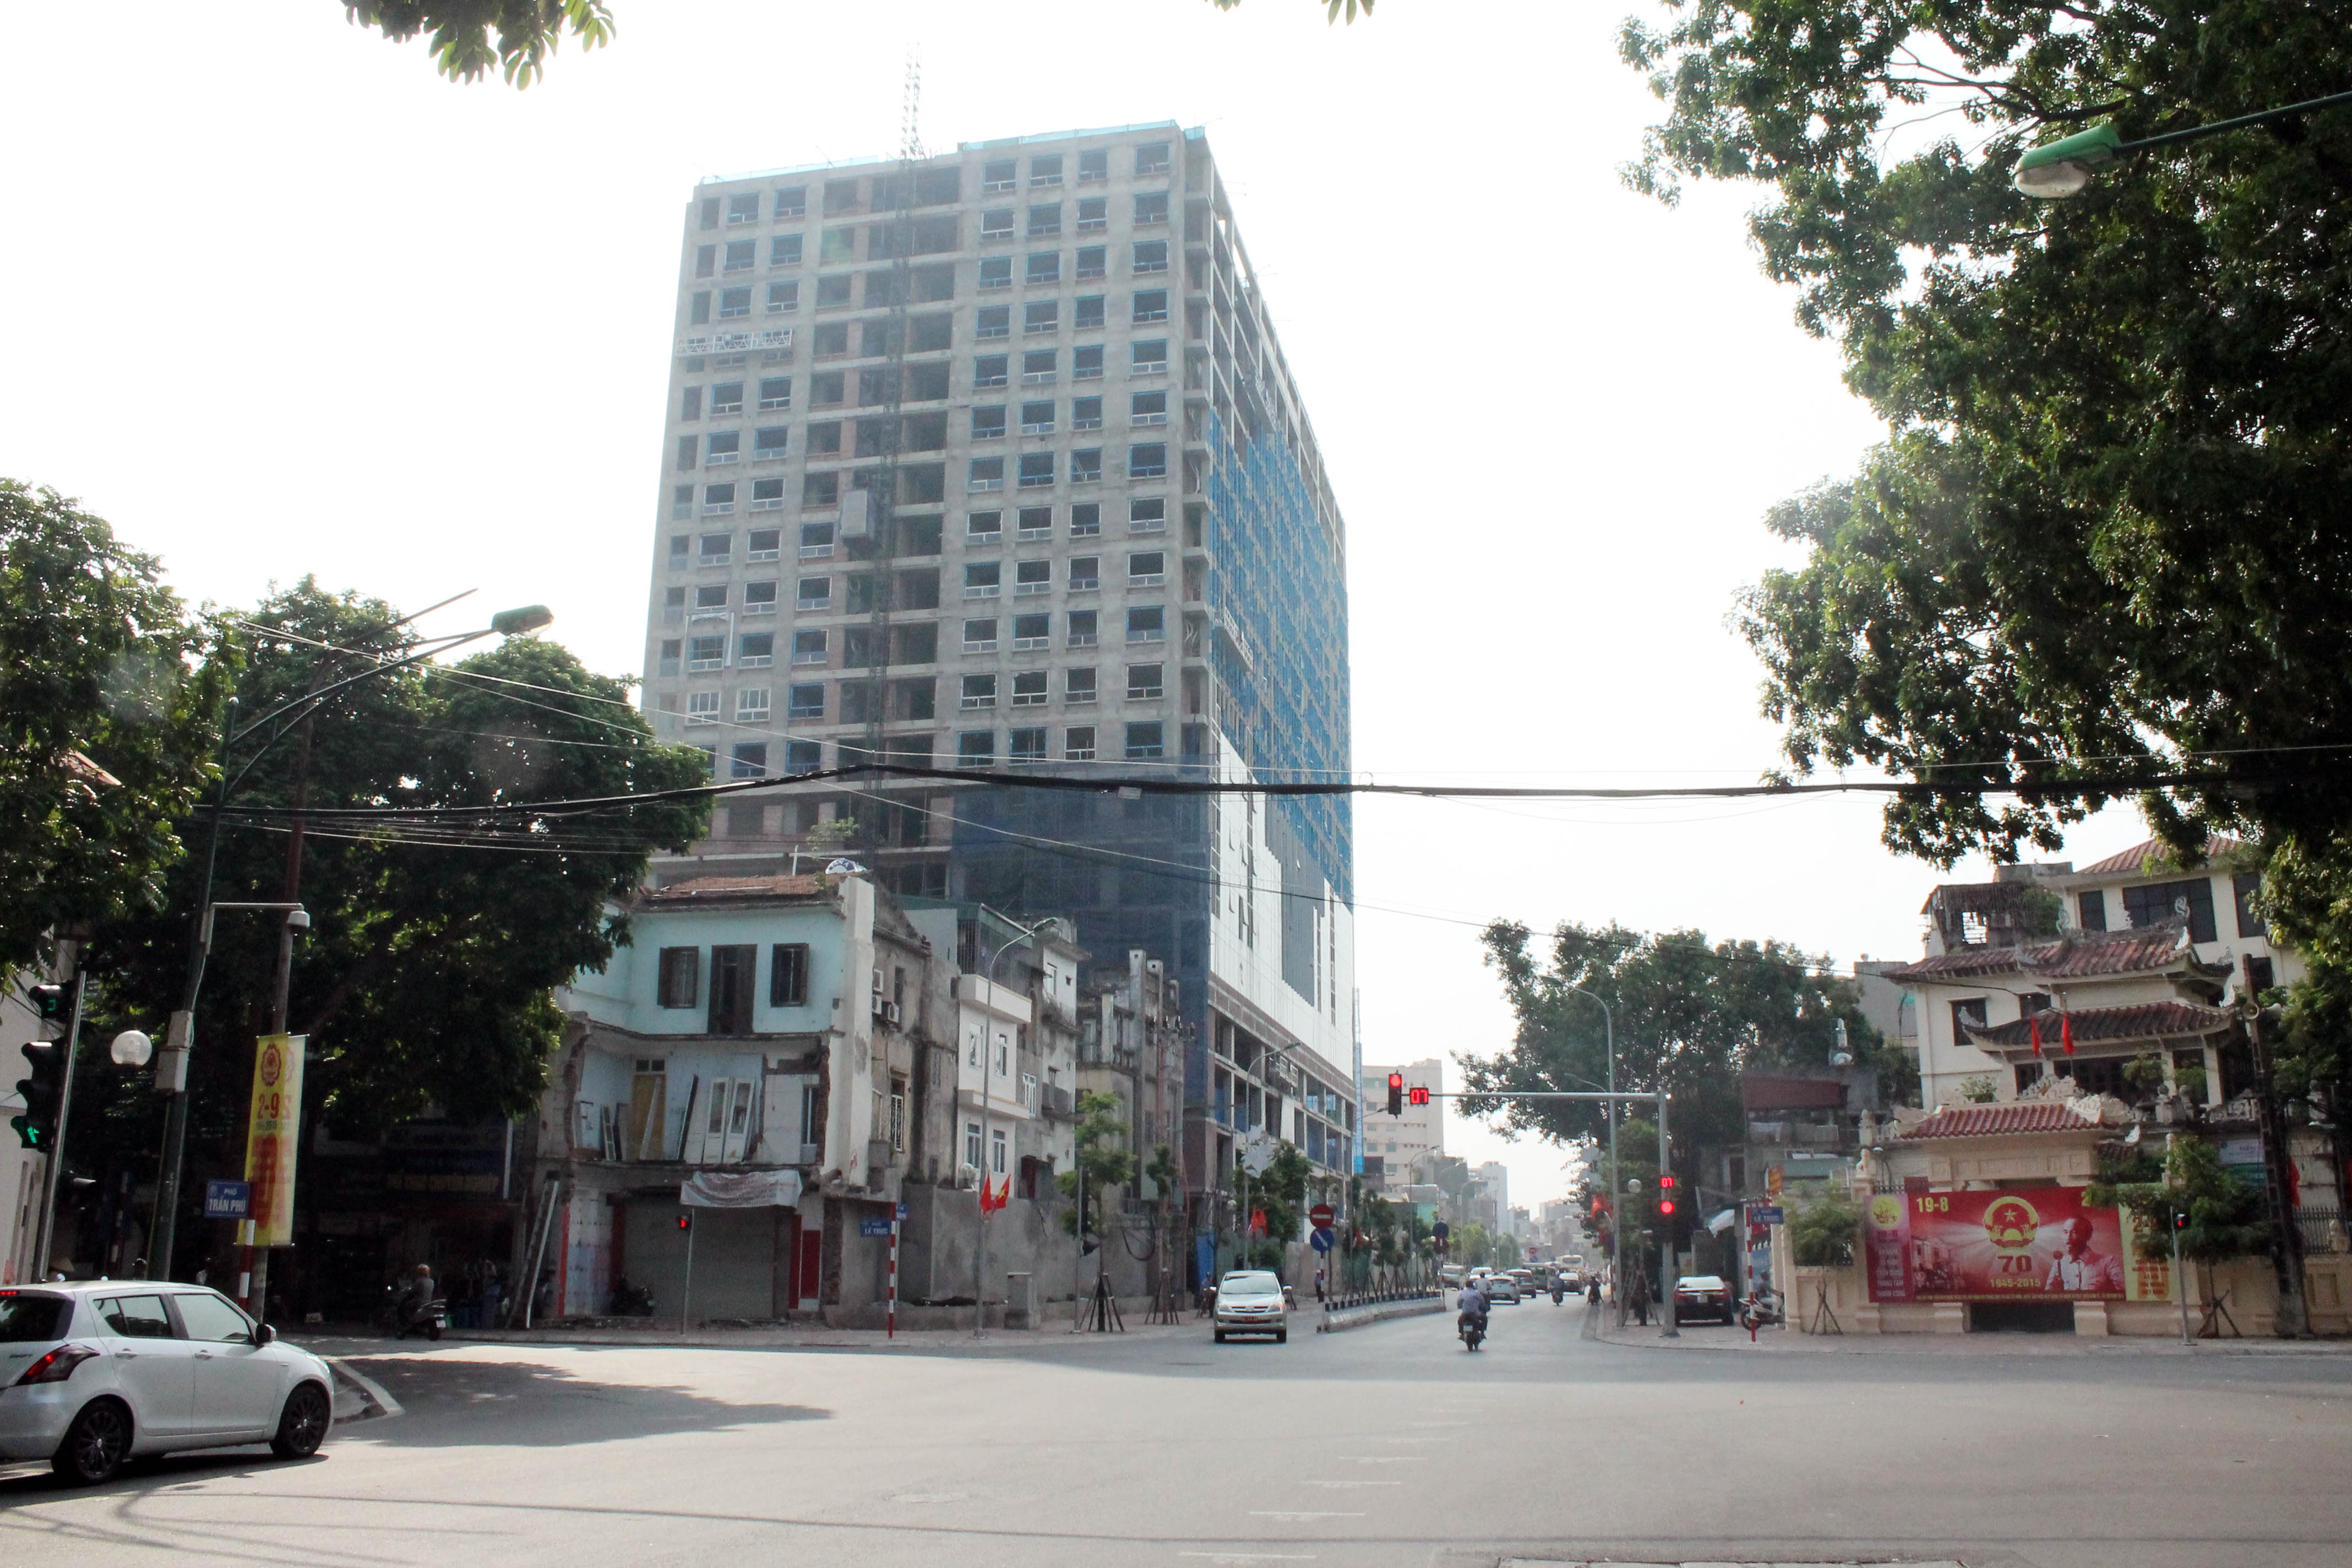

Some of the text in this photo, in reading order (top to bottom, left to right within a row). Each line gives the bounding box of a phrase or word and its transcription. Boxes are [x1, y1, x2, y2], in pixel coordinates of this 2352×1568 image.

[1411, 1090, 1428, 1104] 07
[258, 1093, 280, 1119] 2-9
[1662, 1177, 1672, 1187] 07
[230, 1197, 247, 1212] PHÚ
[1916, 1196, 1949, 1213] 19-8
[1997, 1255, 2032, 1273] 70
[1990, 1278, 2041, 1287] 1945-2015
